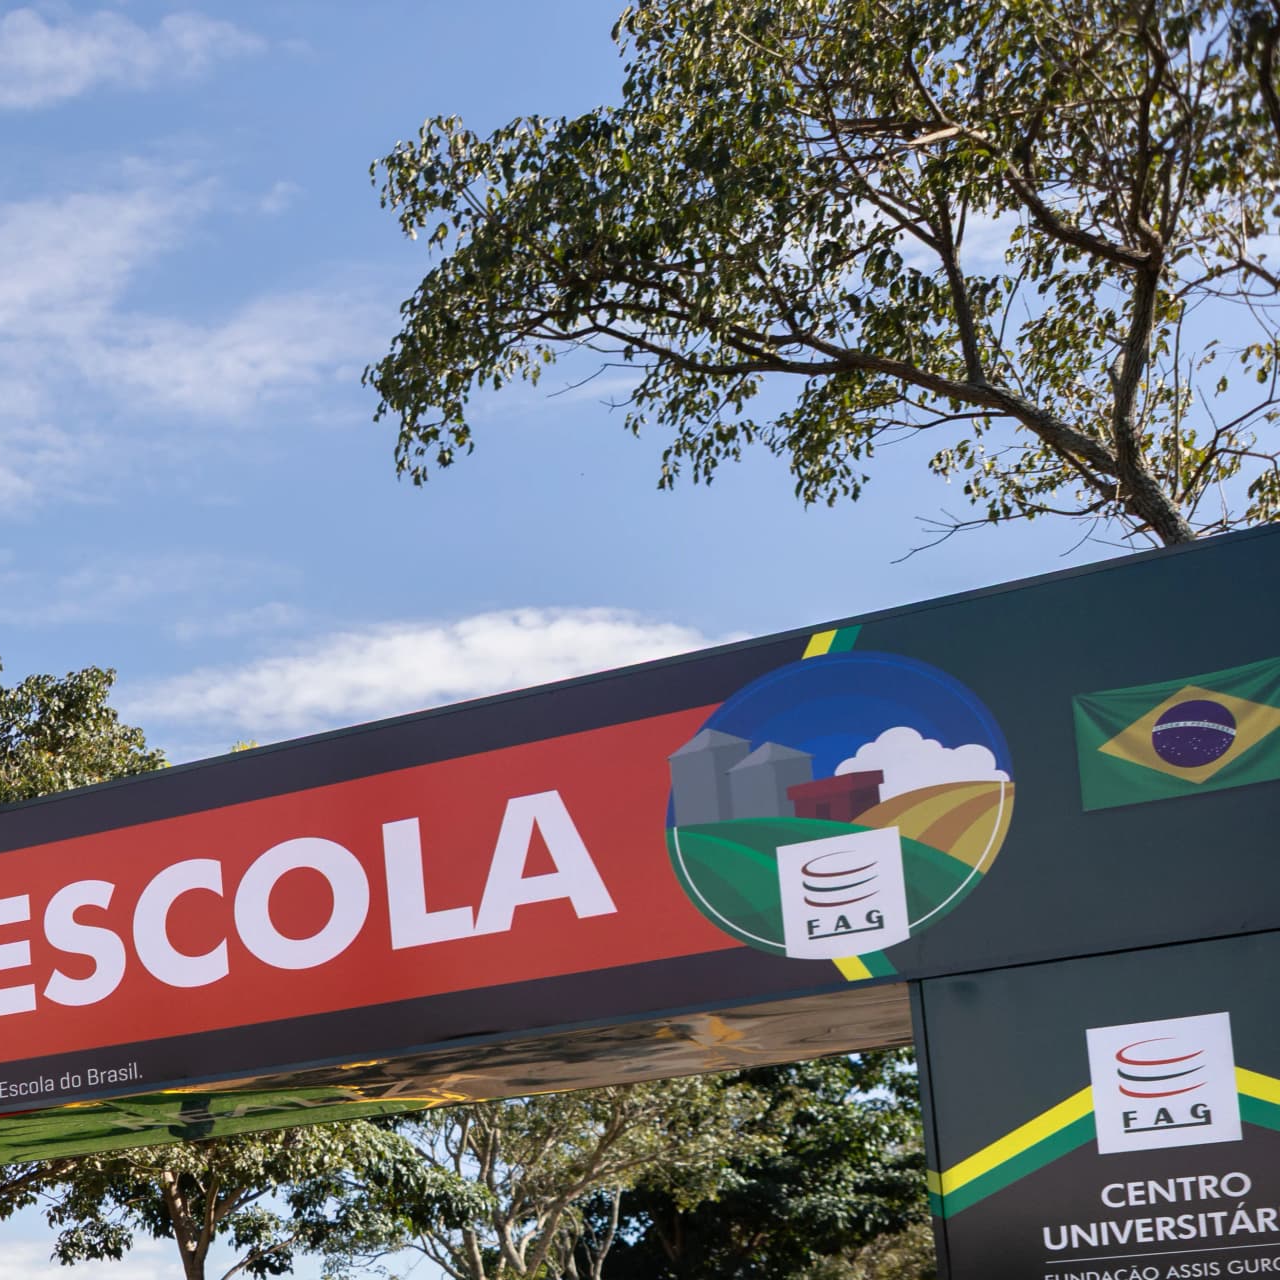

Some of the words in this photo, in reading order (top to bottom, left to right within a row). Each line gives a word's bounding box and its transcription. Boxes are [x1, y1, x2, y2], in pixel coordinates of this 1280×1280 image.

[807, 909, 885, 938] FAG
[60, 1071, 81, 1090] do
[87, 1062, 143, 1086] Brasil.
[1122, 1103, 1212, 1131] FAG
[1101, 1171, 1252, 1208] CENTRO
[1166, 1262, 1221, 1280] ASSIS
